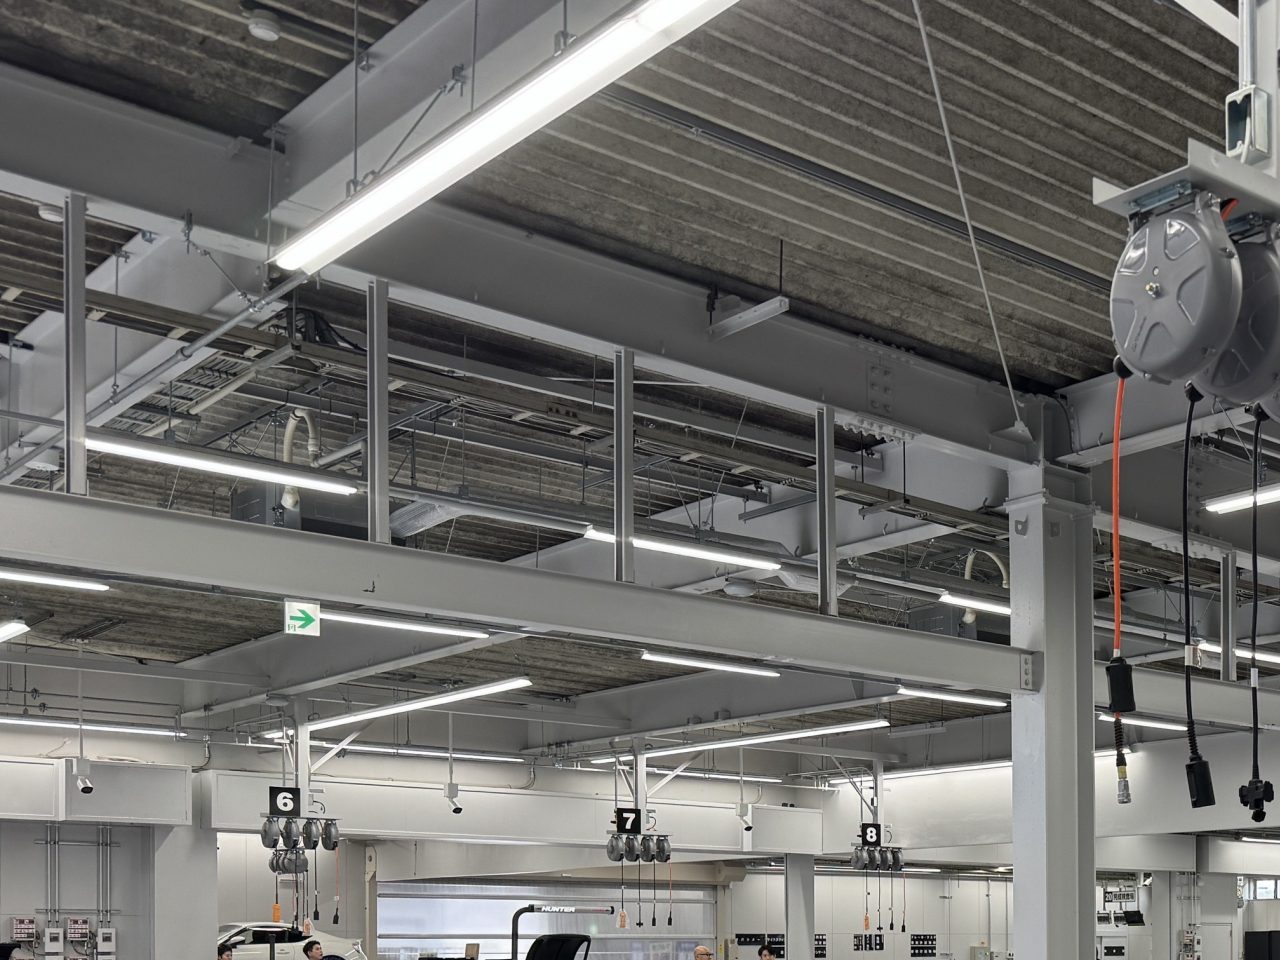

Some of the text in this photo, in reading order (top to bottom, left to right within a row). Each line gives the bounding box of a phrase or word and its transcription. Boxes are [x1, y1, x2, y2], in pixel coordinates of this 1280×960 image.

[277, 792, 294, 812] 6
[622, 812, 636, 830] 7
[866, 827, 877, 842] 8
[541, 905, 576, 913] HUNTER
